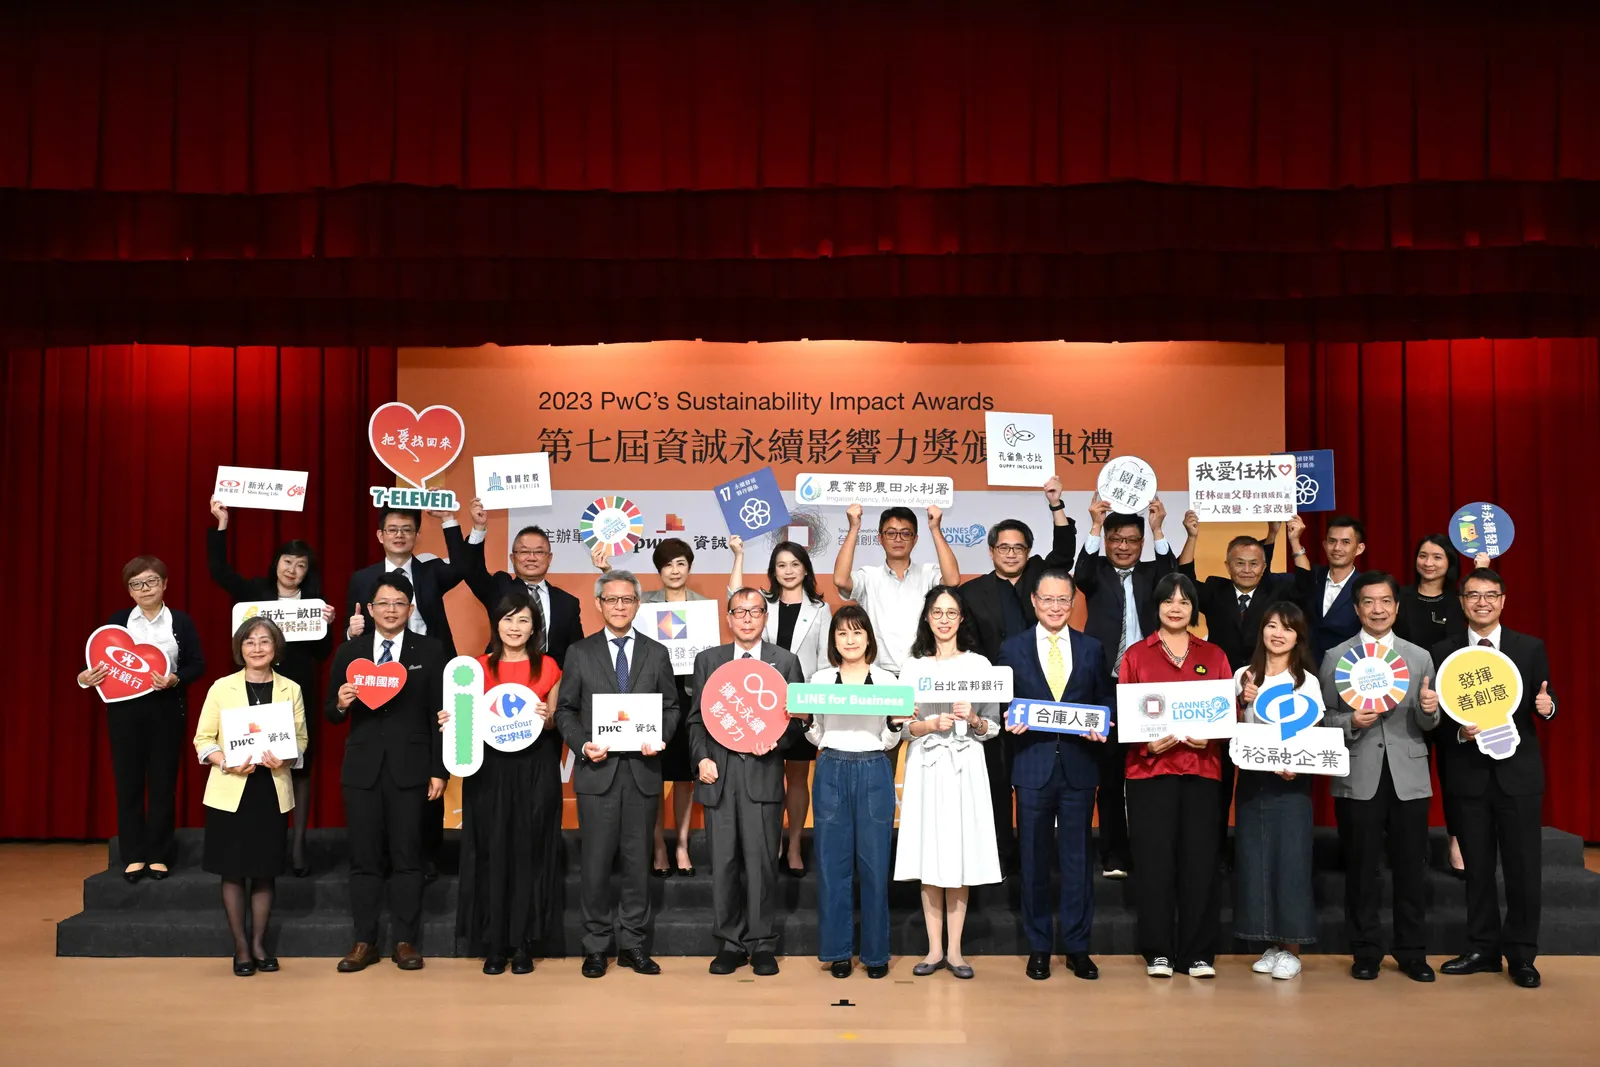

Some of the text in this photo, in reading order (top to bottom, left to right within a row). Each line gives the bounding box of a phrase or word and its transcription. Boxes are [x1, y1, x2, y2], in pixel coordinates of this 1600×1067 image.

[538, 391, 994, 415] 2023 PwC's Sustainability Impact Awards
[381, 427, 452, 463] 把愛找回來
[537, 427, 1114, 465] 第七屆資誠永續影響力獎頒典禮
[1195, 460, 1277, 482] 我愛任林
[247, 481, 284, 491] 新光人壽
[826, 480, 950, 496] 農業部農田水利署
[1119, 470, 1149, 491] 園藝
[719, 486, 732, 502] 17
[1112, 487, 1141, 507] 療育
[1195, 490, 1283, 500] 任林促進父母自我成長
[544, 528, 584, 544] 主辦單
[604, 522, 627, 540] GOALS
[945, 534, 971, 544] ONS
[633, 537, 661, 553] pw
[694, 535, 728, 550] 資誠
[260, 608, 321, 620] 新光一畝田
[121, 651, 135, 667] 光
[353, 674, 399, 688] 宜鼎國際
[934, 680, 1004, 692] 台北富邦銀行
[1360, 680, 1388, 691] GOALS
[1458, 666, 1494, 690] 發揮
[796, 693, 905, 707] LINE for Business
[1456, 683, 1510, 711] 善創意
[718, 681, 767, 736] 擴大永續
[1171, 701, 1211, 710] CANNES
[709, 701, 746, 742] 影響力
[1035, 708, 1099, 729] 合庫人壽
[1172, 708, 1214, 721] LIONS
[490, 719, 533, 733] Carrefour
[597, 723, 657, 735] pwc 資誠
[229, 731, 290, 750] pwc 資誠
[495, 728, 533, 744] 家樂福
[1242, 746, 1342, 769] 裕融企業
